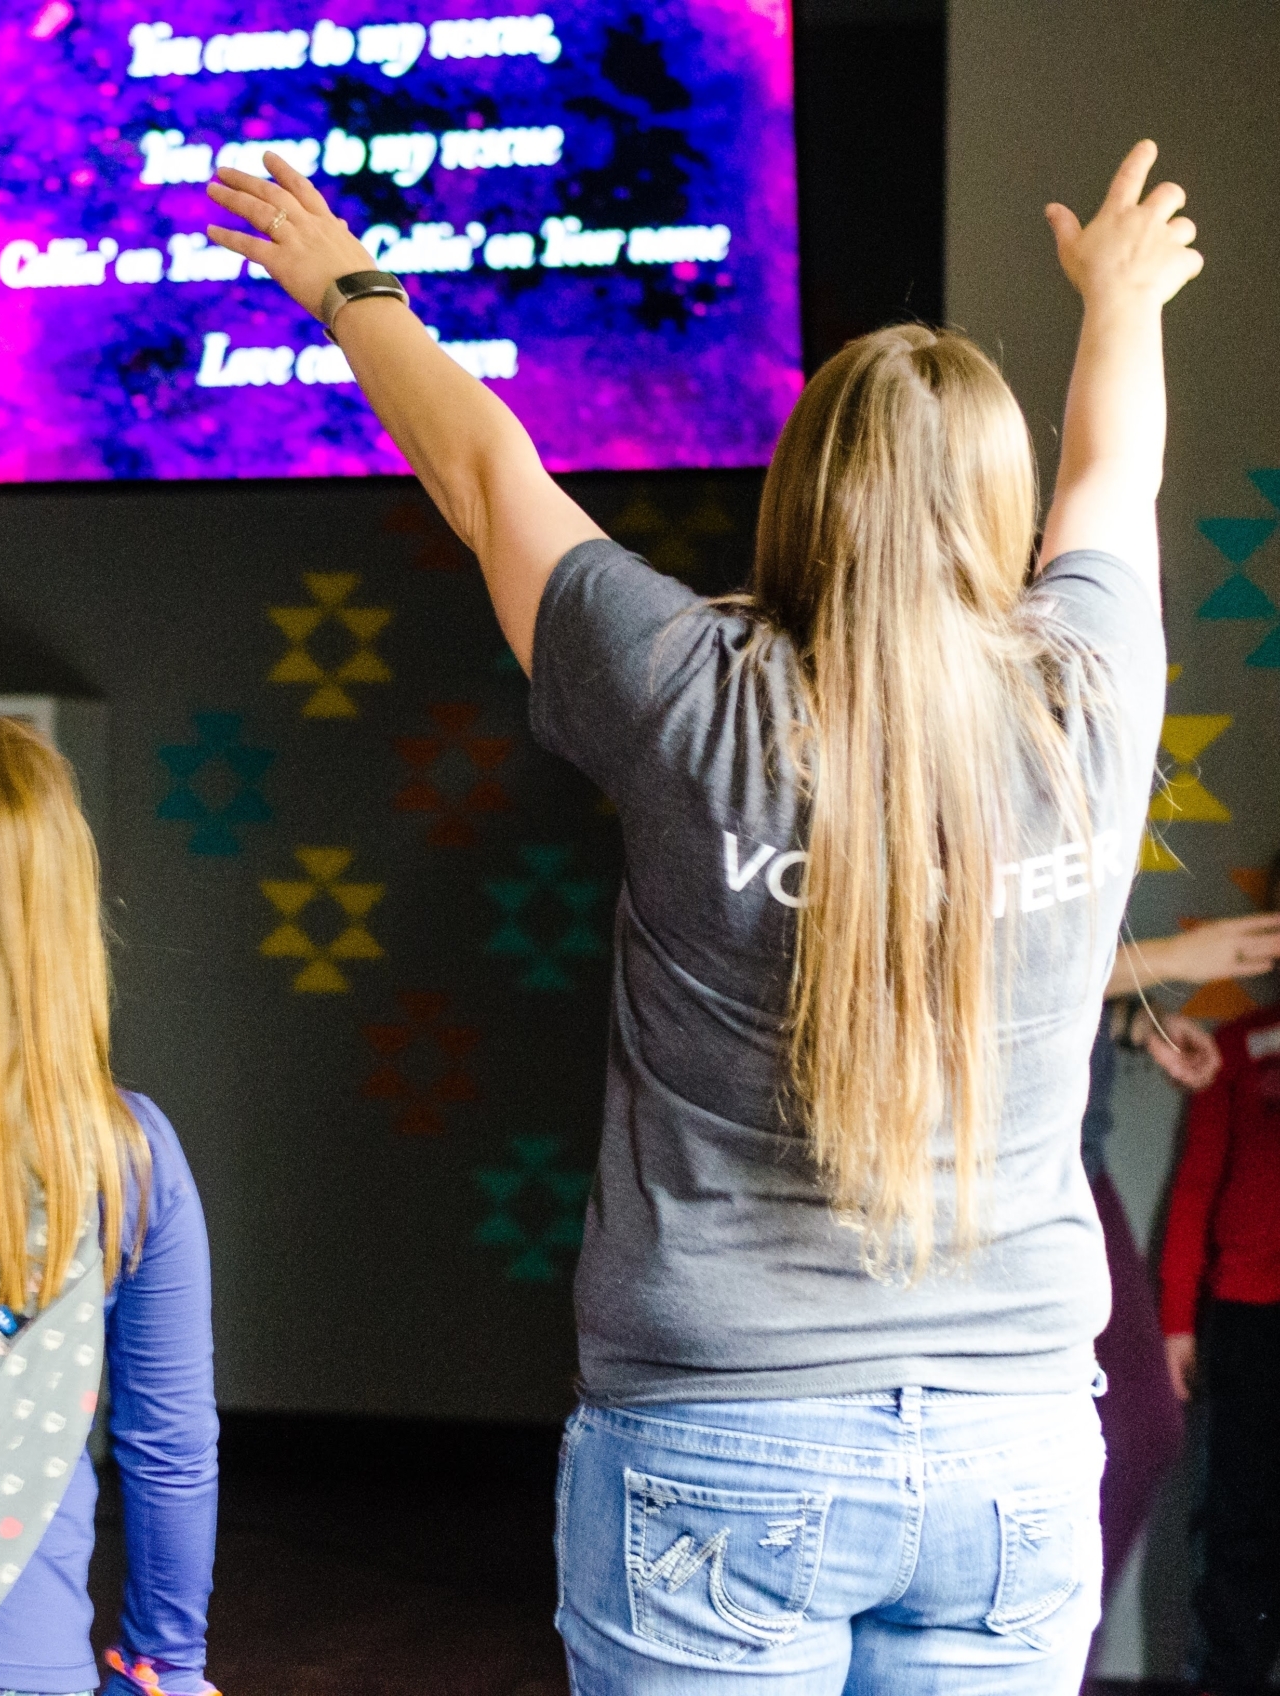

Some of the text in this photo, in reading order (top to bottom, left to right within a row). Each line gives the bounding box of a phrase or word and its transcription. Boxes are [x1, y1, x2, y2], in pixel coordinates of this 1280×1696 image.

[128, 22, 202, 77] You
[204, 30, 309, 73] came
[310, 19, 355, 66] to
[357, 23, 426, 77] my
[140, 129, 213, 184] You
[322, 127, 366, 175] to
[369, 132, 437, 187] my
[440, 125, 564, 170] rescue
[115, 247, 163, 284] on
[483, 232, 535, 269] on
[540, 216, 626, 267] Your
[627, 224, 731, 264] name
[196, 332, 295, 387] Love
